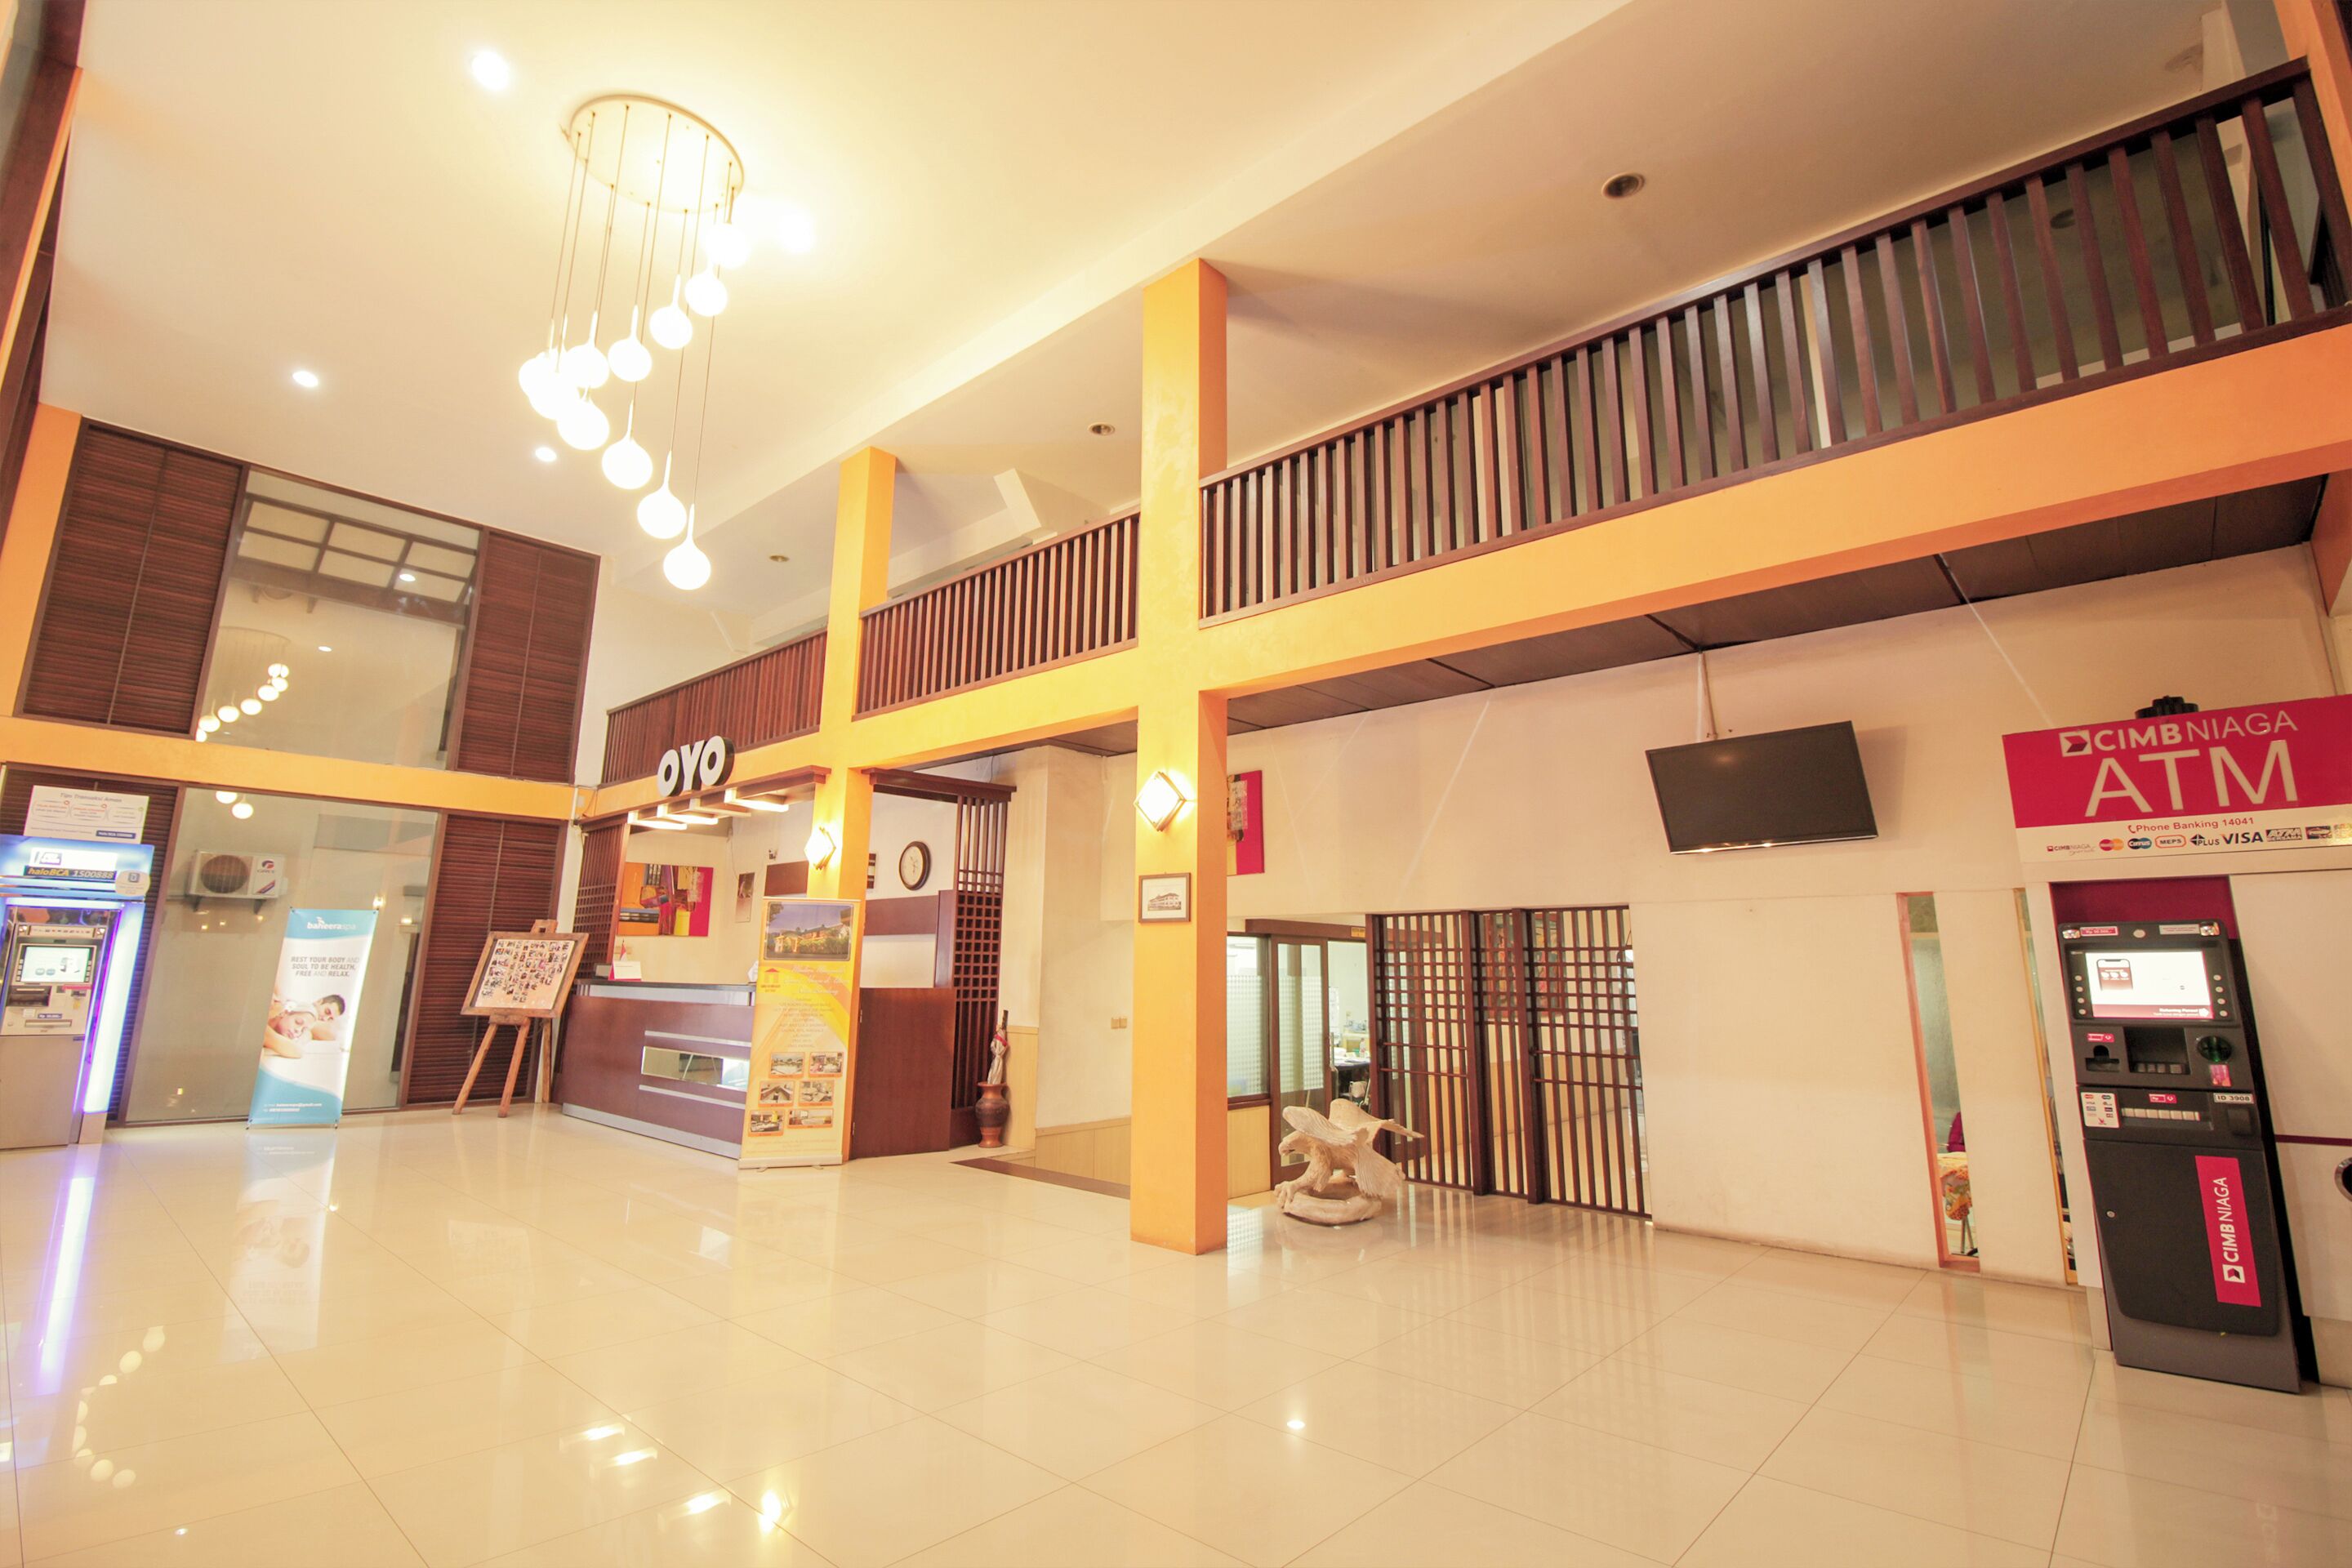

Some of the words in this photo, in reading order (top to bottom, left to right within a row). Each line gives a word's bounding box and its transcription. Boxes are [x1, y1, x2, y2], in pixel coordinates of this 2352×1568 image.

[657, 735, 728, 797] OYO
[2085, 739, 2299, 817] ATM
[2136, 824, 2170, 832] Phone
[2173, 818, 2219, 830] Banking
[2222, 817, 2254, 826] 14041
[2198, 838, 2220, 846] PLUS
[2221, 831, 2264, 844] VISA
